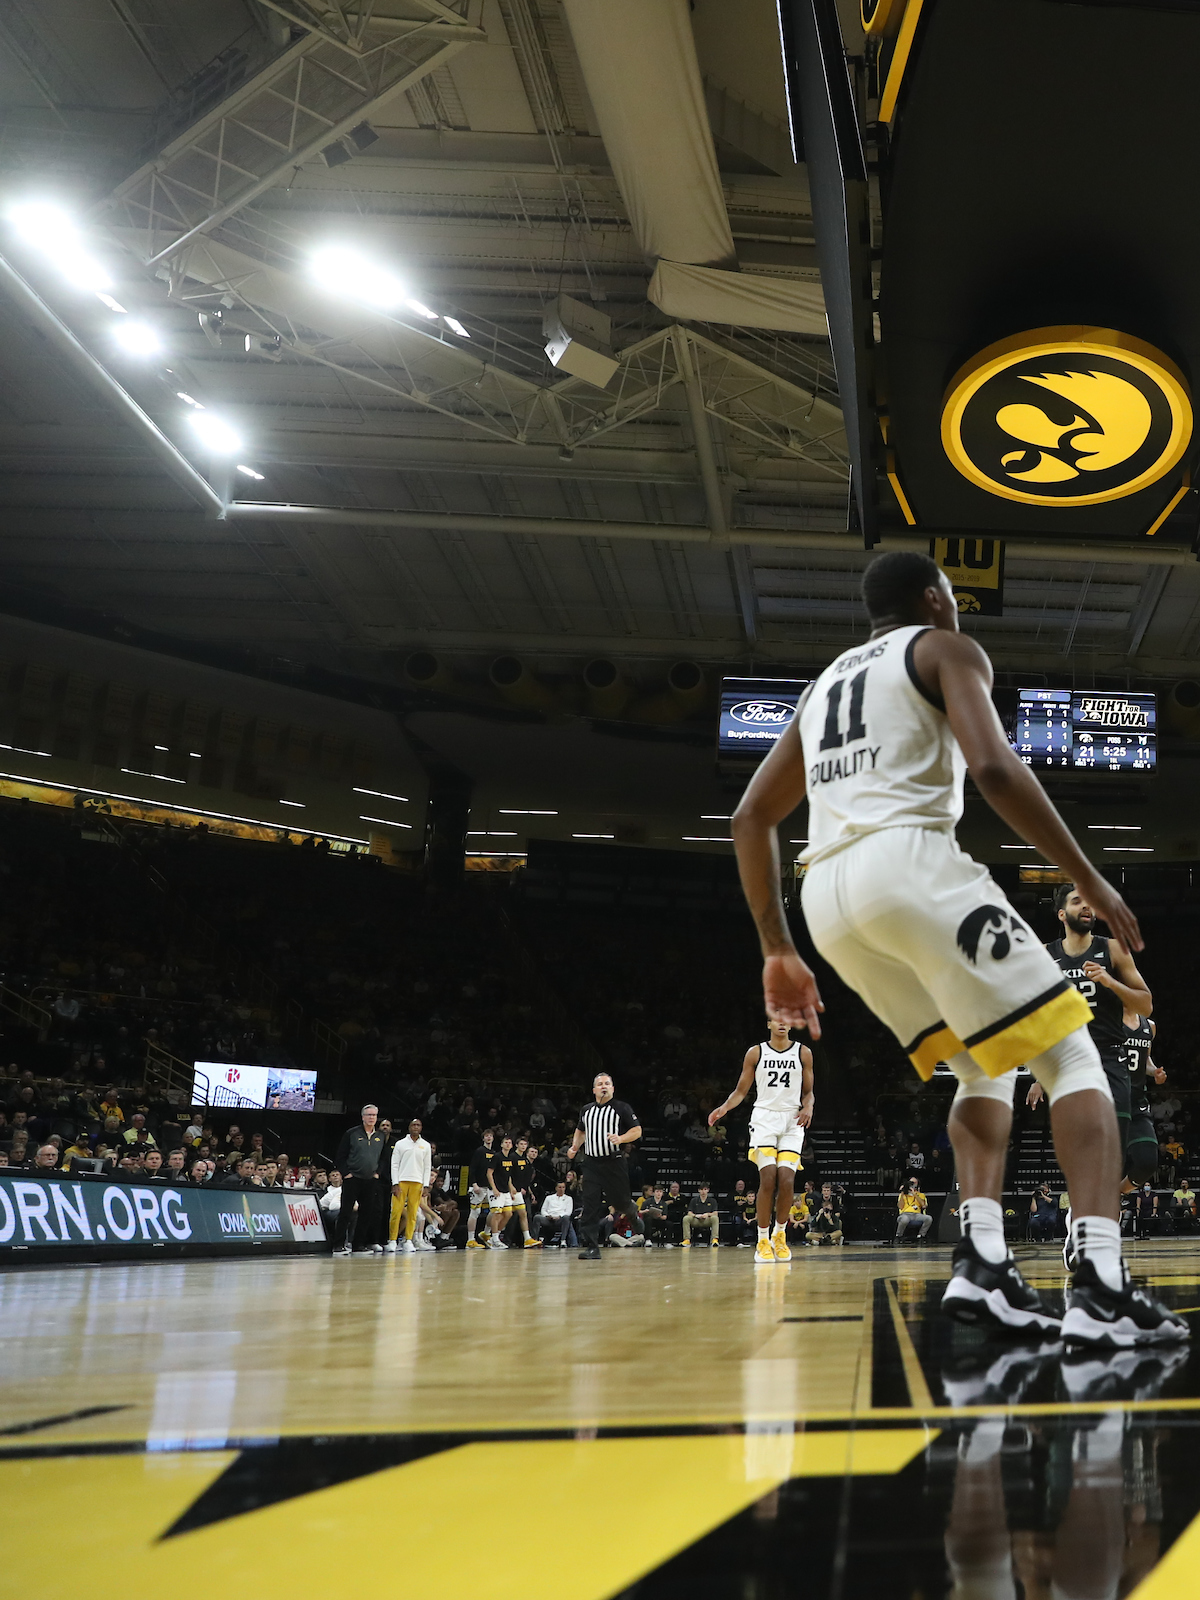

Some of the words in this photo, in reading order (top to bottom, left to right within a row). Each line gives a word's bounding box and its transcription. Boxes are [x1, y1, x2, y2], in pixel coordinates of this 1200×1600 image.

[741, 703, 788, 722] Ford
[819, 666, 869, 752] 11
[1024, 708, 1031, 717] 1
[1046, 709, 1053, 717] 0
[1062, 709, 1068, 718] 1
[1081, 699, 1127, 712] FIGHT
[1125, 705, 1140, 713] FOR
[1023, 719, 1030, 727] 3
[1046, 720, 1053, 728] 0
[1061, 721, 1068, 729] 0
[1101, 712, 1149, 727] IOWA
[1023, 731, 1030, 739] 5
[1046, 732, 1053, 740] 3
[1062, 732, 1068, 741] 1
[1021, 743, 1032, 752] 22
[1046, 744, 1053, 753] 4
[1080, 745, 1094, 757] 21
[1103, 746, 1127, 757] 5:25
[1136, 747, 1150, 759] 11
[1046, 756, 1053, 765] 0
[1061, 757, 1068, 766] 2
[1072, 981, 1097, 1007] 2
[763, 1060, 796, 1070] IOWA
[1127, 1049, 1140, 1072] 3
[767, 1071, 791, 1088] 24
[218, 1213, 249, 1232] IOWA
[251, 1213, 281, 1232] CORN
